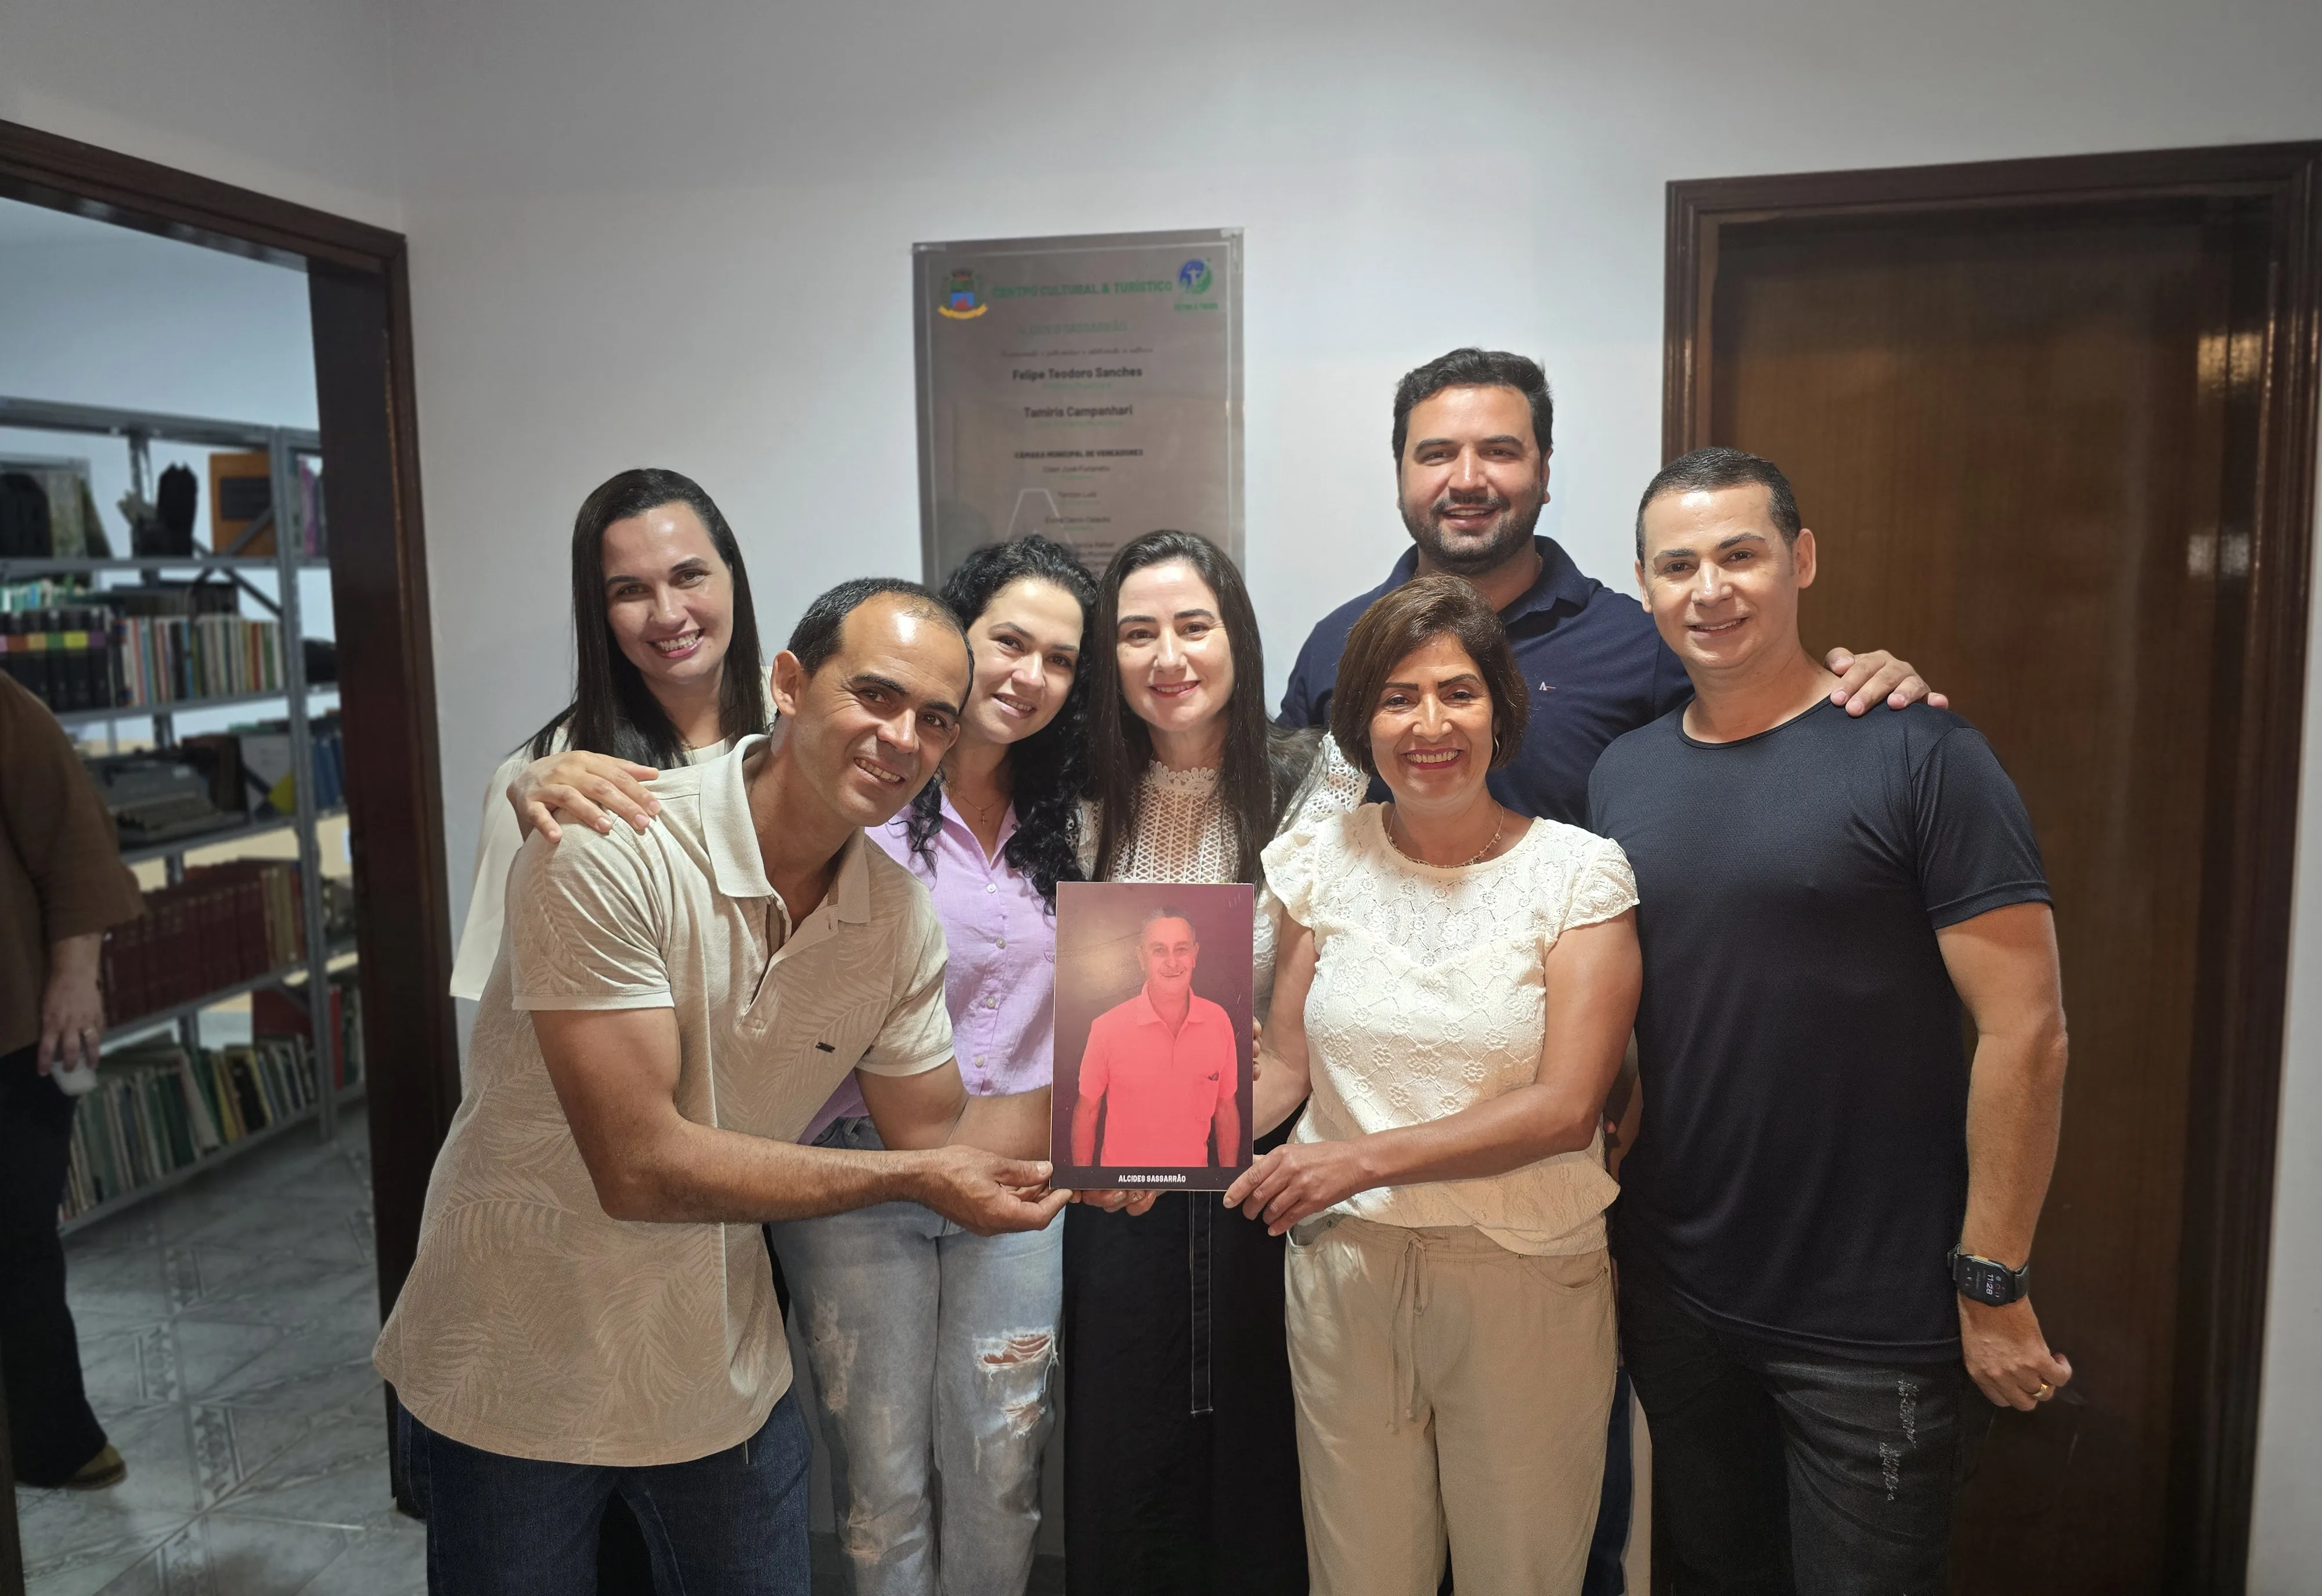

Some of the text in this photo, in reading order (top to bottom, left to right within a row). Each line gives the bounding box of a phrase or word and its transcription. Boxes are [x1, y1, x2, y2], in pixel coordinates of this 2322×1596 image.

[993, 284, 1037, 298] CENTRO
[1040, 283, 1100, 296] CULTURAL
[1112, 279, 1172, 294] TURÍSTICO
[1012, 366, 1143, 382] Felipe Teodoro Sanches
[1023, 404, 1133, 418] Tamiris Campanhari
[1118, 1173, 1186, 1183] ALCIDES SASSARRÃO
